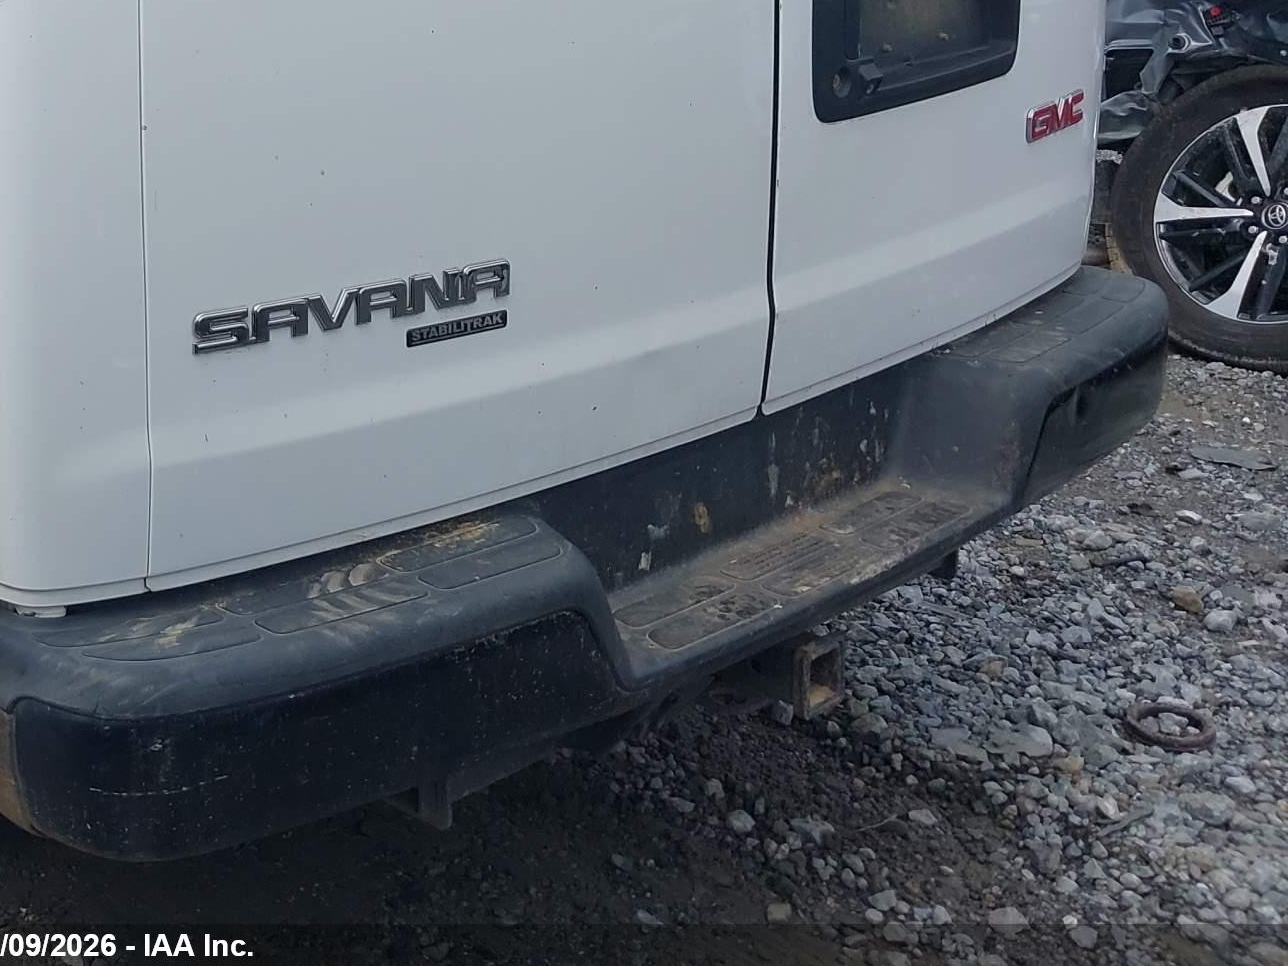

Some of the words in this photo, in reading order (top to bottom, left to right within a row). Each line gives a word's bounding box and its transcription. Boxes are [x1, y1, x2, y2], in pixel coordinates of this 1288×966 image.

[1025, 89, 1084, 144] GMC
[192, 258, 510, 355] SAVANA
[410, 311, 504, 344] STABILITRAK
